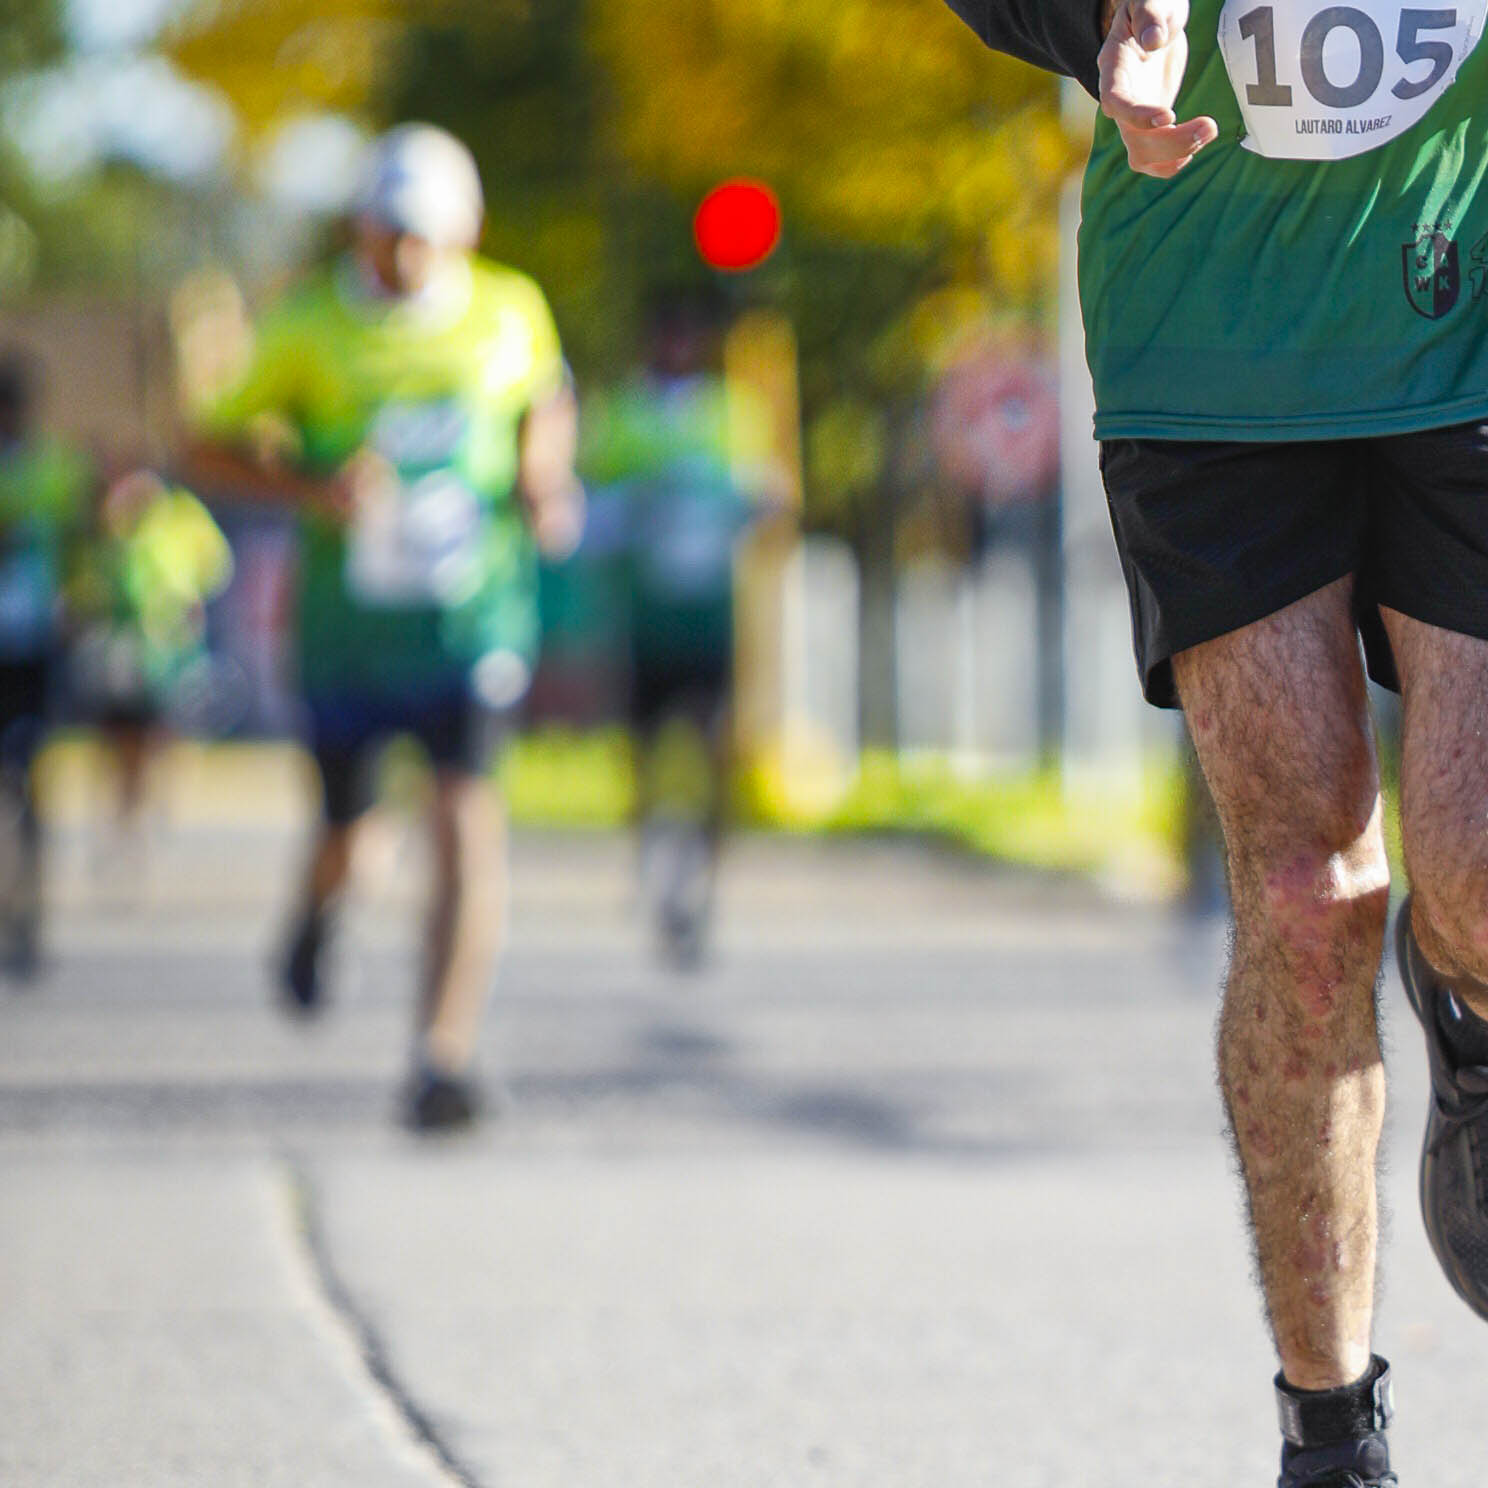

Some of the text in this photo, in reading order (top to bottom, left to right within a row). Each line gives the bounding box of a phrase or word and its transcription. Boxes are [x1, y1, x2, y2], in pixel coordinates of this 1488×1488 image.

[1238, 6, 1457, 109] 105
[1295, 115, 1392, 134] LAUTARO ALVAREZ
